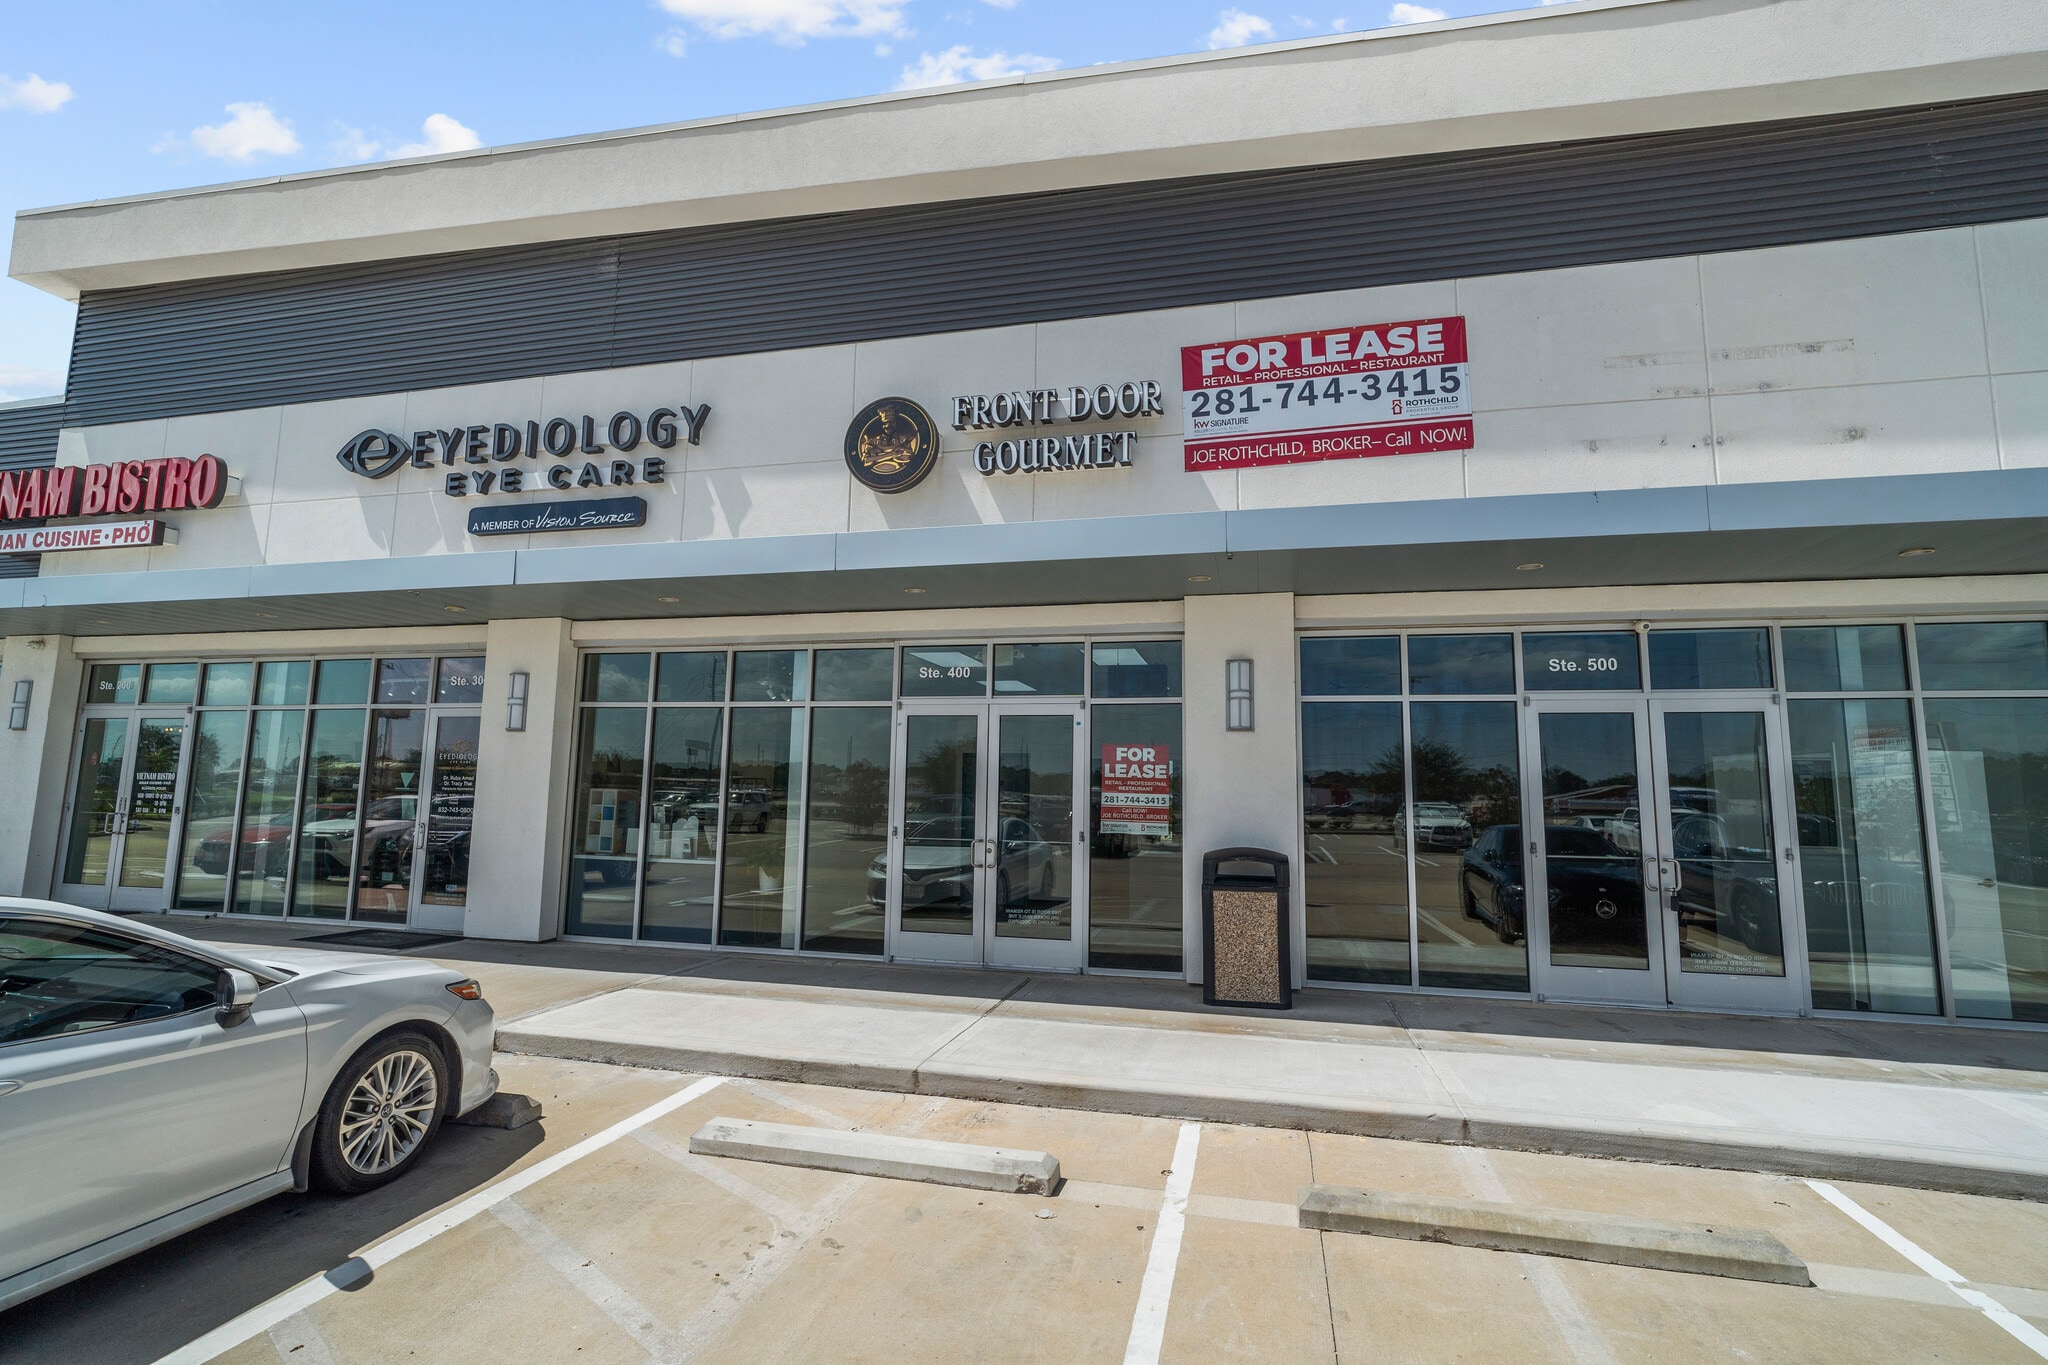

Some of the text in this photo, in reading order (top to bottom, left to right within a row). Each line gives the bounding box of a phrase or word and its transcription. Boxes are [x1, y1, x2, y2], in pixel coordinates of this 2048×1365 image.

[1201, 322, 1445, 376] FOR LEASE
[1203, 374, 1243, 387] RETAIL
[1254, 363, 1348, 381] PROFESSIONAL
[1360, 353, 1444, 370] RESTAURANT
[1191, 366, 1461, 418] 281-744-3415
[951, 388, 1058, 431] FRONT
[1067, 380, 1164, 422] DOOR
[1405, 396, 1459, 406] ROTHCHILD
[1210, 417, 1249, 427] SIGNATURE
[411, 403, 711, 468] EYEDIOLOGY
[972, 430, 1137, 476] GOURMET
[1191, 450, 1217, 464] JOE
[1218, 441, 1306, 460] ROTHCHILD,
[1385, 432, 1411, 447] Call
[1420, 427, 1467, 445] NOW!
[445, 457, 665, 497] EYE CARE
[0, 453, 228, 519] NAM BISTRO
[472, 522, 479, 531] A
[481, 519, 519, 531] MEMBER
[521, 519, 535, 529] OF
[32, 529, 102, 548] CUISINE
[919, 666, 971, 678] Ste. 400
[1548, 657, 1618, 671] Ste. 500
[99, 680, 115, 690] Ste.
[450, 675, 485, 686] Ste. 30
[1116, 747, 1155, 762] FOR
[136, 772, 175, 780] VIETNAM BISTRO
[1104, 763, 1167, 779] LEASE
[1104, 795, 1166, 805] 281-744-3415
